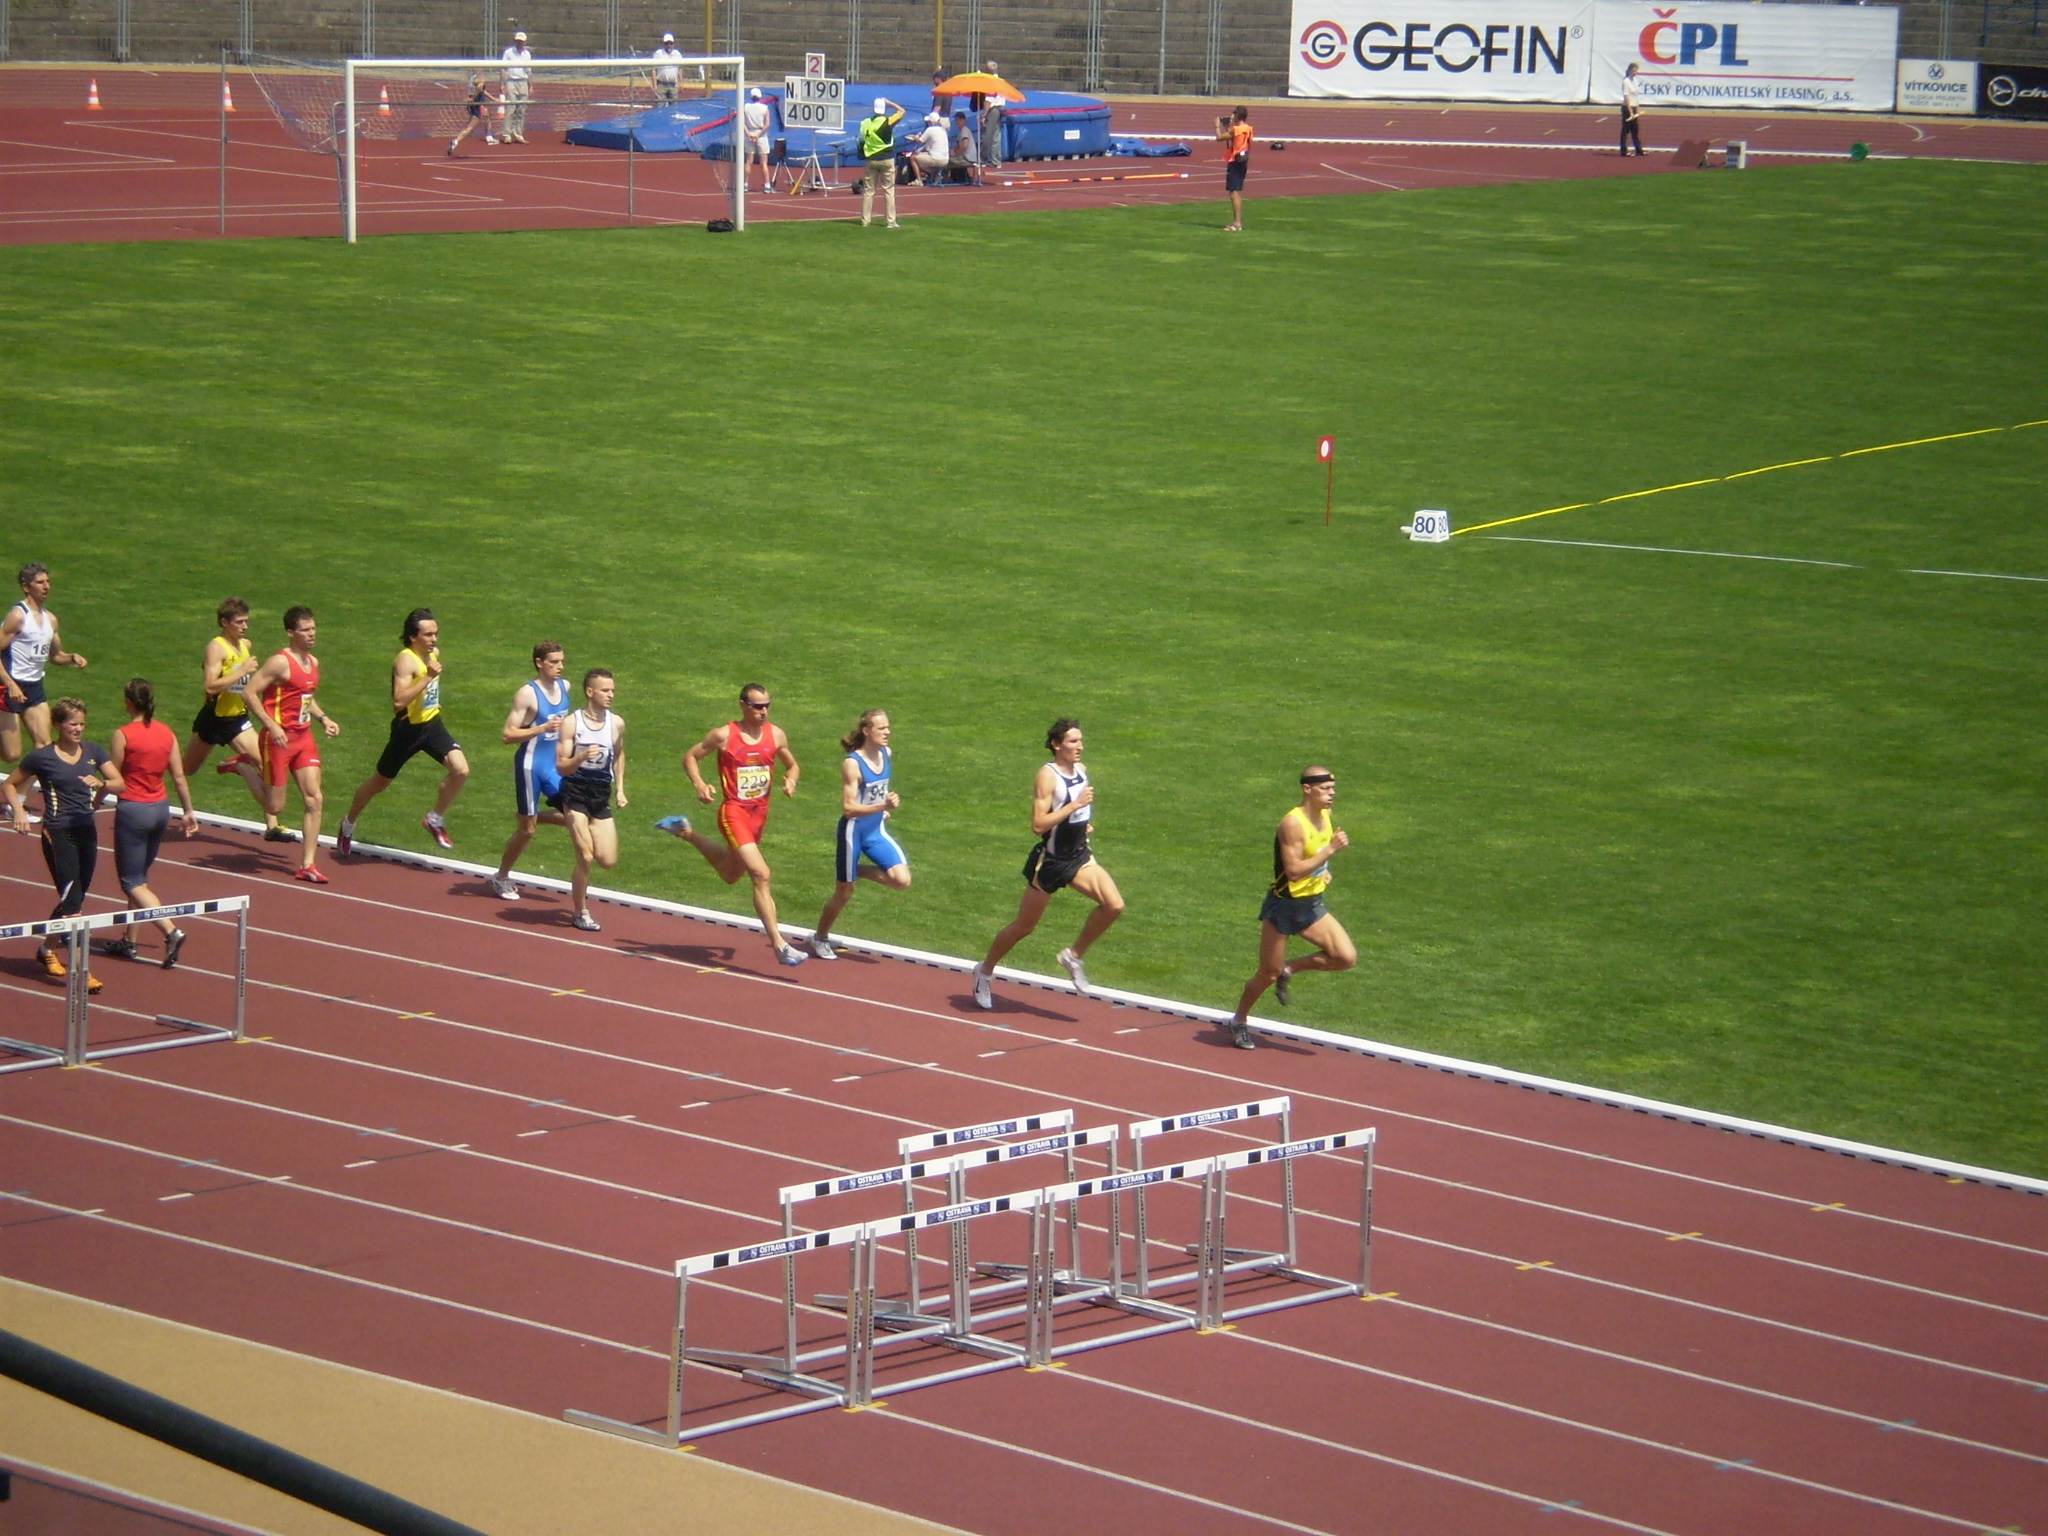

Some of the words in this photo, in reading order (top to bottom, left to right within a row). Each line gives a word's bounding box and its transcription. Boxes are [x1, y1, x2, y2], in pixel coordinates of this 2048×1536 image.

[1638, 9, 1748, 66] ČPL
[1353, 21, 1567, 74] GEOFIN
[809, 57, 820, 73] 2
[804, 81, 839, 98] 190
[1675, 83, 1771, 98] PODNIKATELSKÝ
[1776, 87, 1828, 100] LEASING,
[1904, 79, 1967, 92] VÍTKOVICE
[788, 104, 826, 122] 400
[1415, 516, 1435, 534] 80
[740, 775, 767, 789] 229
[972, 1125, 999, 1136] OSTRAVA
[1026, 1139, 1052, 1151] OSTRAVA
[1284, 1143, 1309, 1153] OSTRAVA
[857, 1172, 884, 1185] OSTRAVA
[1120, 1173, 1146, 1185] OSTRAVA
[945, 1206, 972, 1217] OSTRAVA
[758, 1242, 787, 1254] OSTRAVA
